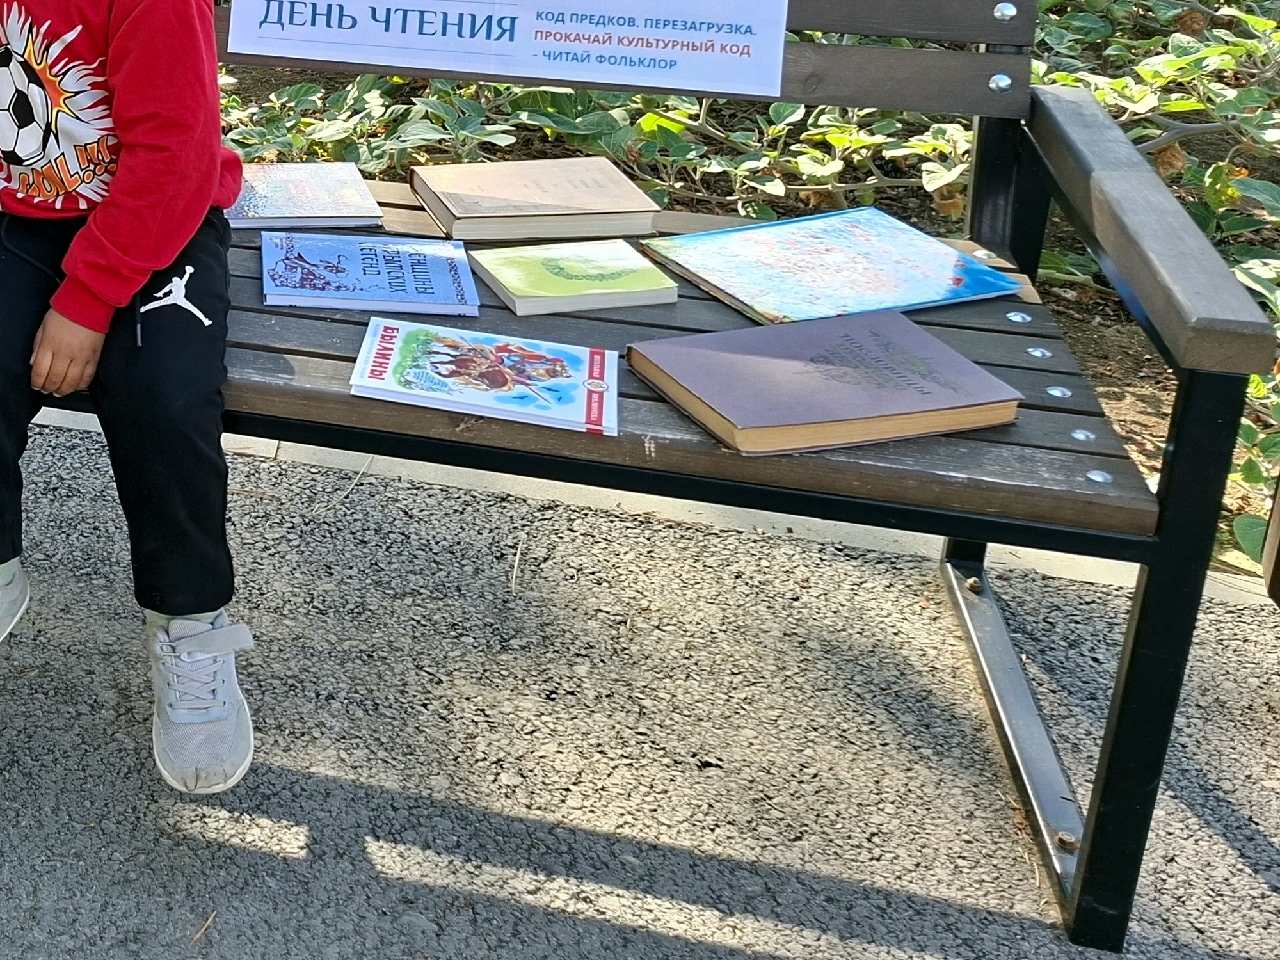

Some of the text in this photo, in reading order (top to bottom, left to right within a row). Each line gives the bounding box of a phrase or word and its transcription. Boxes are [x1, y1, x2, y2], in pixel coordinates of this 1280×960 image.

[368, 5, 520, 43] ЧТЕНИЯ
[535, 10, 757, 36] КОД ПРЕДКОВ. ПЕРЕЗАГРУЗКА.
[533, 30, 752, 58] ПРОКАЧАЙ КУЛЬТУРНЫЙ КОД
[542, 50, 591, 64] ЧИТАЙ
[595, 53, 678, 70] ФОЛЬКЛОР
[381, 244, 409, 294] РЫМСКИХ
[406, 245, 435, 295] ЕНЩИНЫ
[367, 325, 400, 381] БЫЛИНЫ
